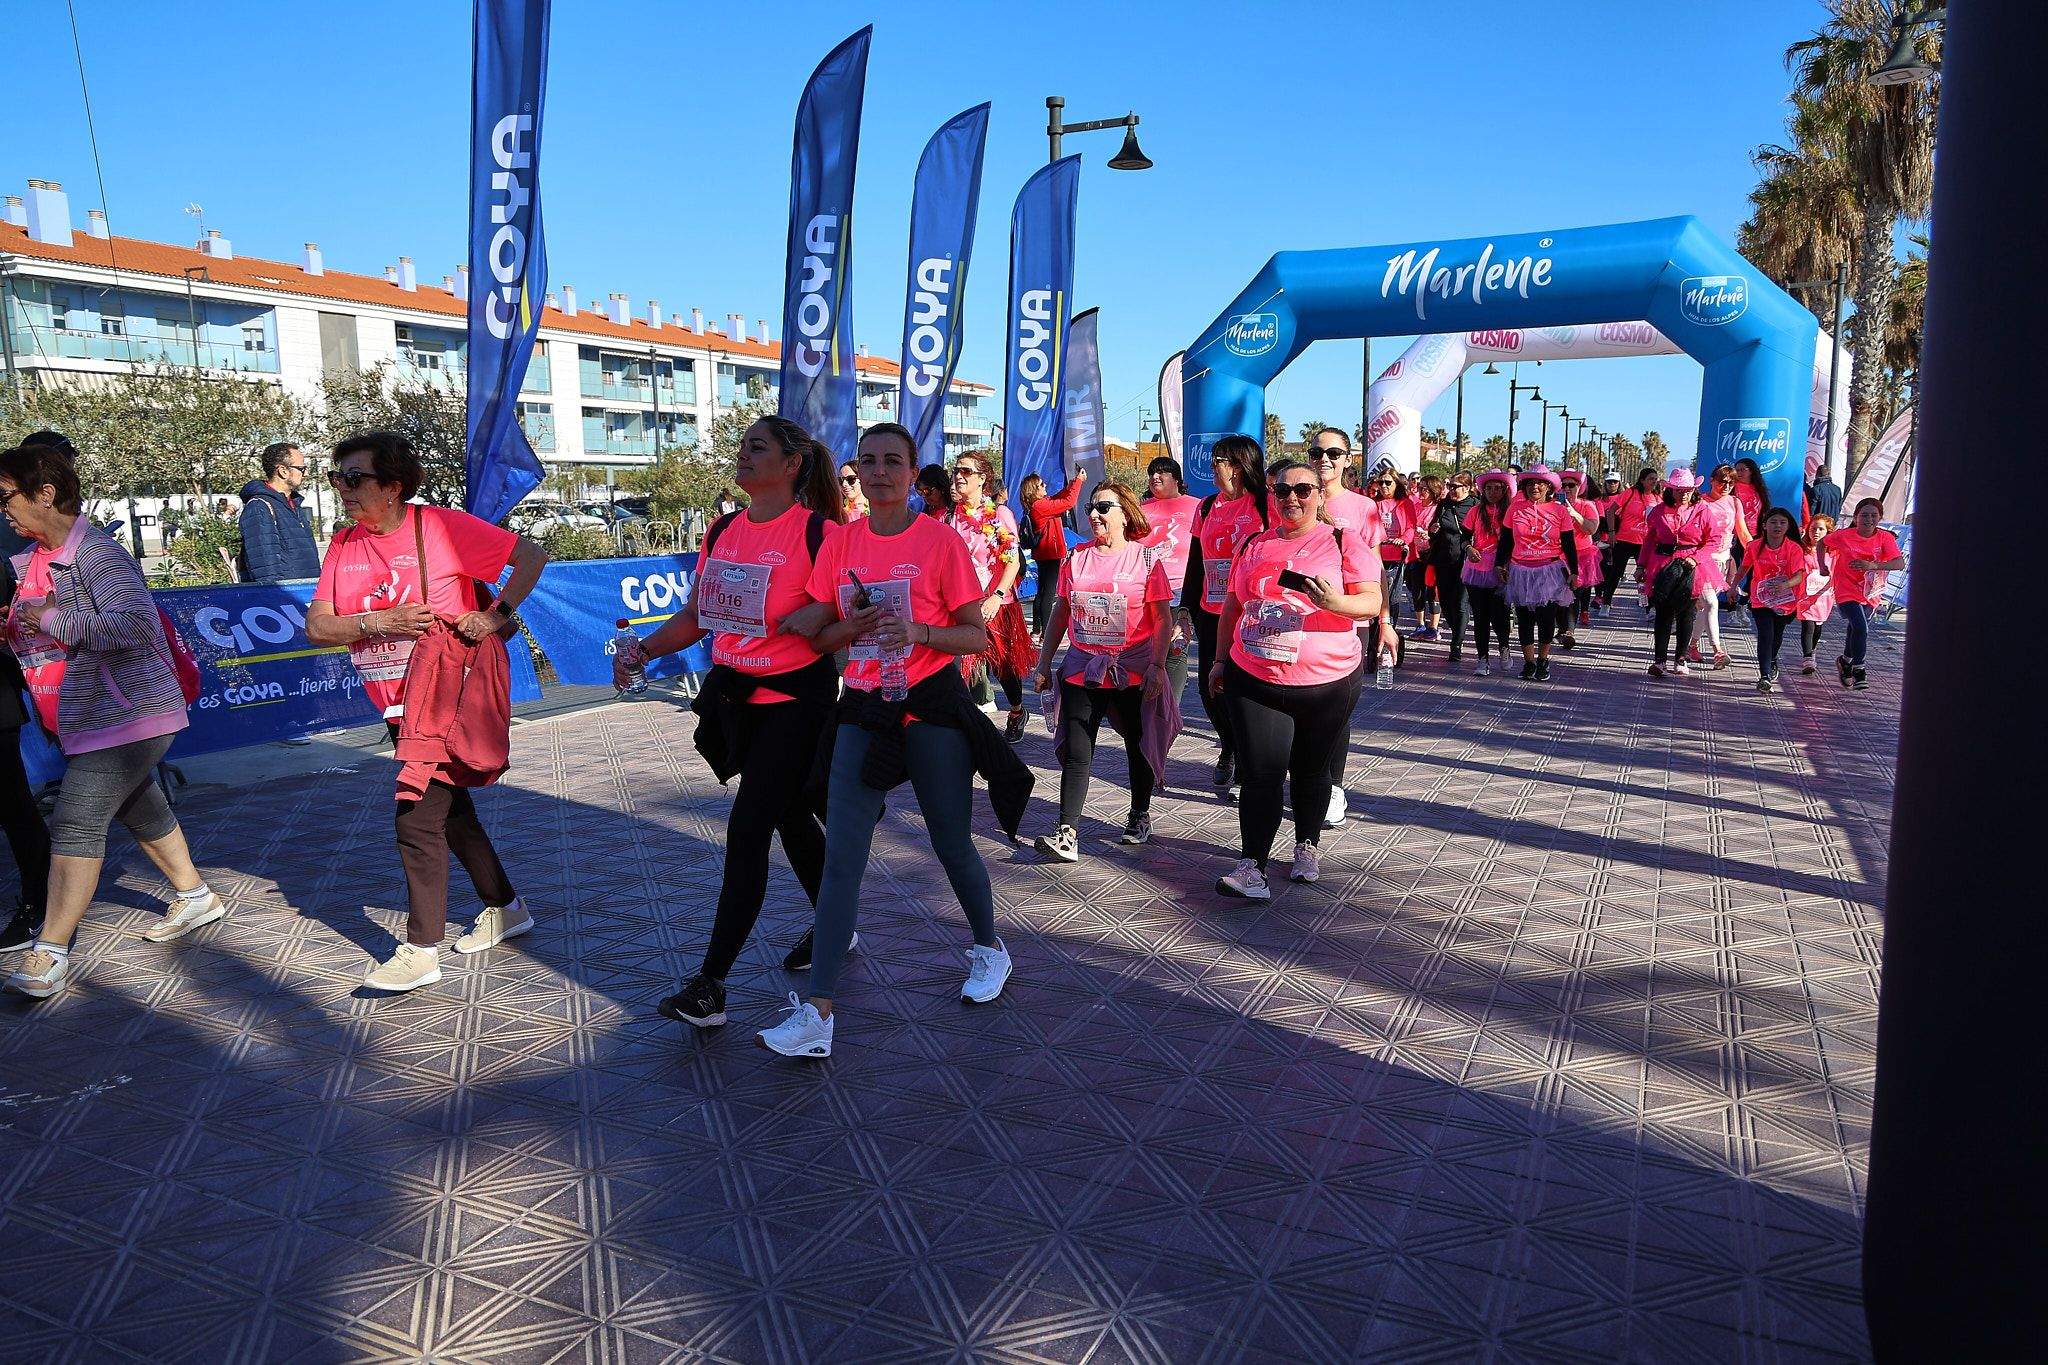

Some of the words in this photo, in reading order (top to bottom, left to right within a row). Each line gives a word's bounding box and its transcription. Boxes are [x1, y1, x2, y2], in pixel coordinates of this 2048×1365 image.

[486, 115, 532, 339] GOYA
[795, 214, 838, 378] GOYA
[1381, 243, 1553, 321] Marlene
[1685, 286, 1744, 314] Marlene
[906, 258, 952, 397] GOYA
[1229, 323, 1274, 346] Marlene
[1470, 329, 1519, 350] COSMO
[1599, 322, 1654, 344] COSMO
[1017, 290, 1052, 411] GOYA
[1367, 409, 1401, 448] OSMO
[1721, 431, 1785, 460] Marlene
[620, 567, 697, 616] GOY
[718, 592, 743, 608] 016
[195, 604, 312, 654] GO
[1089, 615, 1109, 626] 016
[1259, 625, 1281, 637] 016
[371, 641, 396, 653] 016
[742, 656, 771, 667] MUJER
[199, 693, 221, 709] es
[224, 682, 285, 705] GOYA
[341, 676, 365, 700] qu
